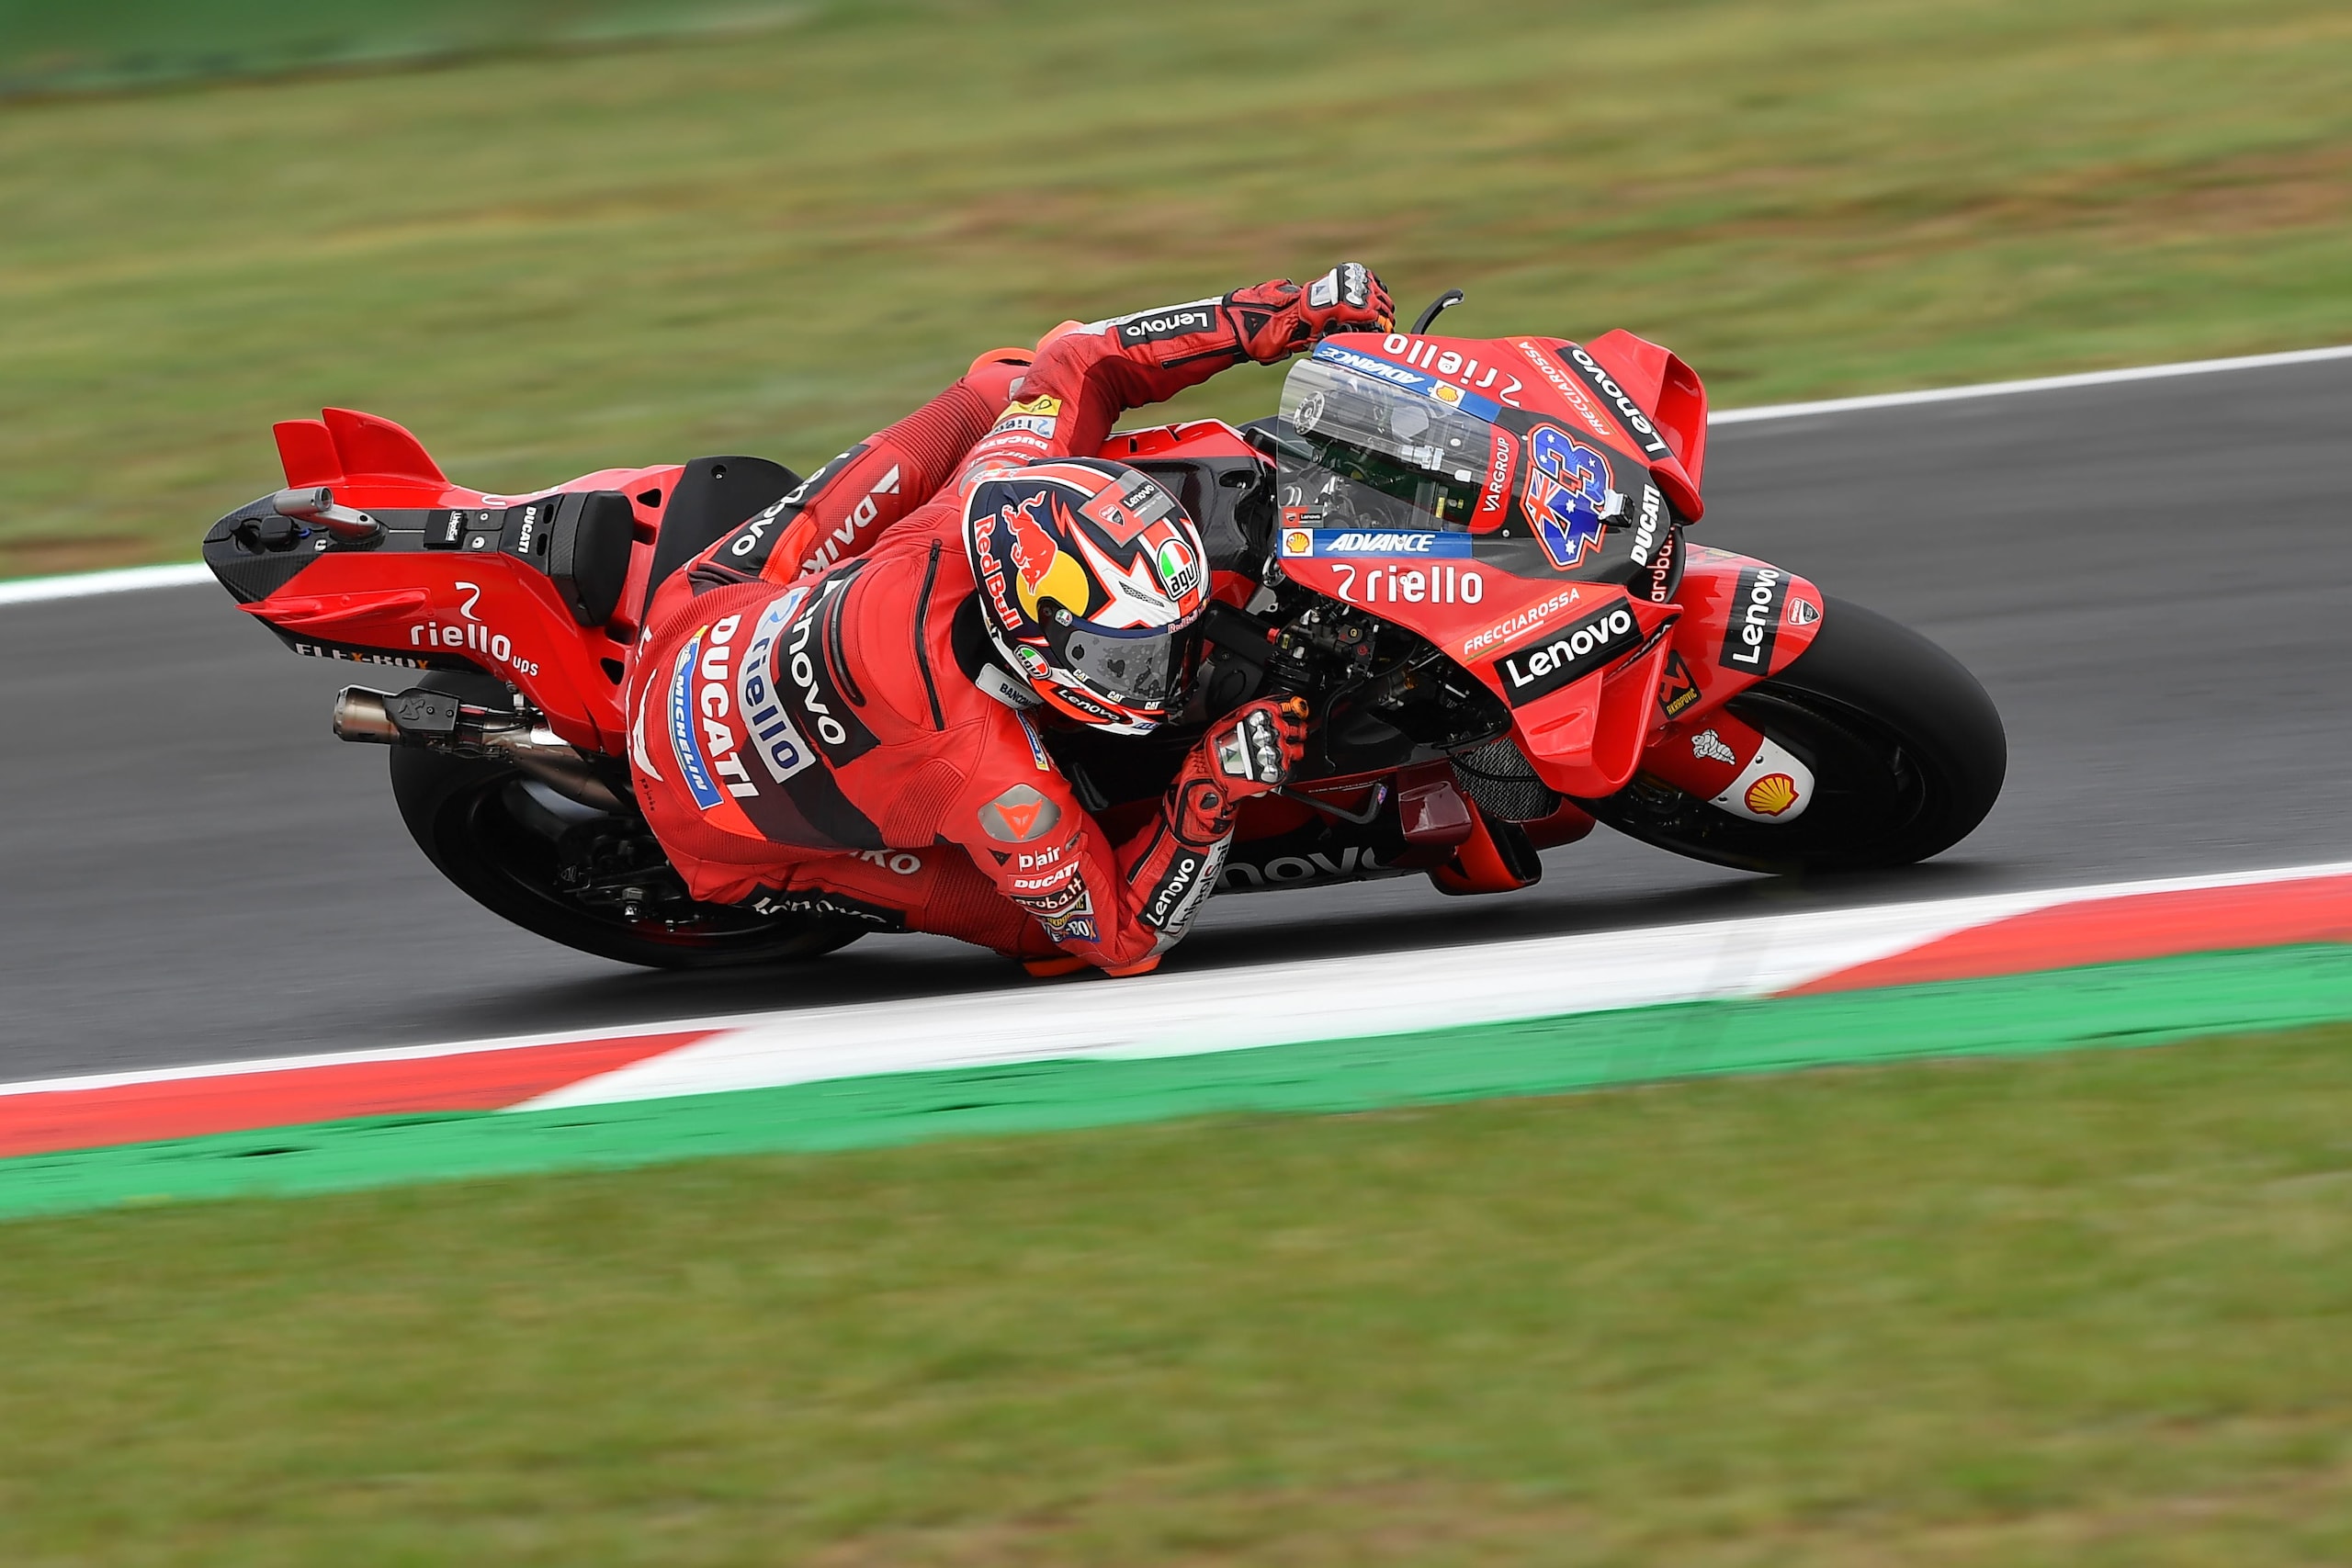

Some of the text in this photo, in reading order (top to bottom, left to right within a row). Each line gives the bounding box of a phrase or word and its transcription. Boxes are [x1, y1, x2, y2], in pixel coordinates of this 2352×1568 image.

[1125, 311, 1209, 337] Lenovo
[1319, 347, 1425, 384] ADVANCE
[1383, 333, 1498, 389] riello
[1519, 341, 1611, 436] FRECCIAROSSA
[1571, 349, 1667, 453] Lenovo
[1123, 484, 1155, 508] Lenovo
[1482, 436, 1509, 513] VARGROUP
[1522, 424, 1615, 570] 43
[517, 506, 537, 554] DUCATI
[973, 513, 1003, 576] Red
[1326, 534, 1436, 552] ADVANCE
[1630, 483, 1660, 567] DUCATI
[986, 570, 1023, 631] Bull
[1170, 563, 1195, 592] agv
[1366, 565, 1484, 604] riello
[1464, 587, 1581, 656] FRECCIAROSSA
[1733, 568, 1781, 665] Lenovo
[411, 622, 539, 678] riello ups
[1072, 669, 1090, 682] CAT
[1505, 609, 1633, 689] Lenovo
[701, 614, 761, 798] DUCATI
[745, 637, 800, 770] riello
[1057, 689, 1121, 721] Lenovo
[1107, 691, 1125, 703] CAT
[1144, 701, 1161, 710] CAT
[672, 674, 708, 792] MICHELIN
[1013, 861, 1080, 889] DUCATI
[1015, 877, 1082, 909] aruba.it
[1146, 858, 1195, 927] Lenovo
